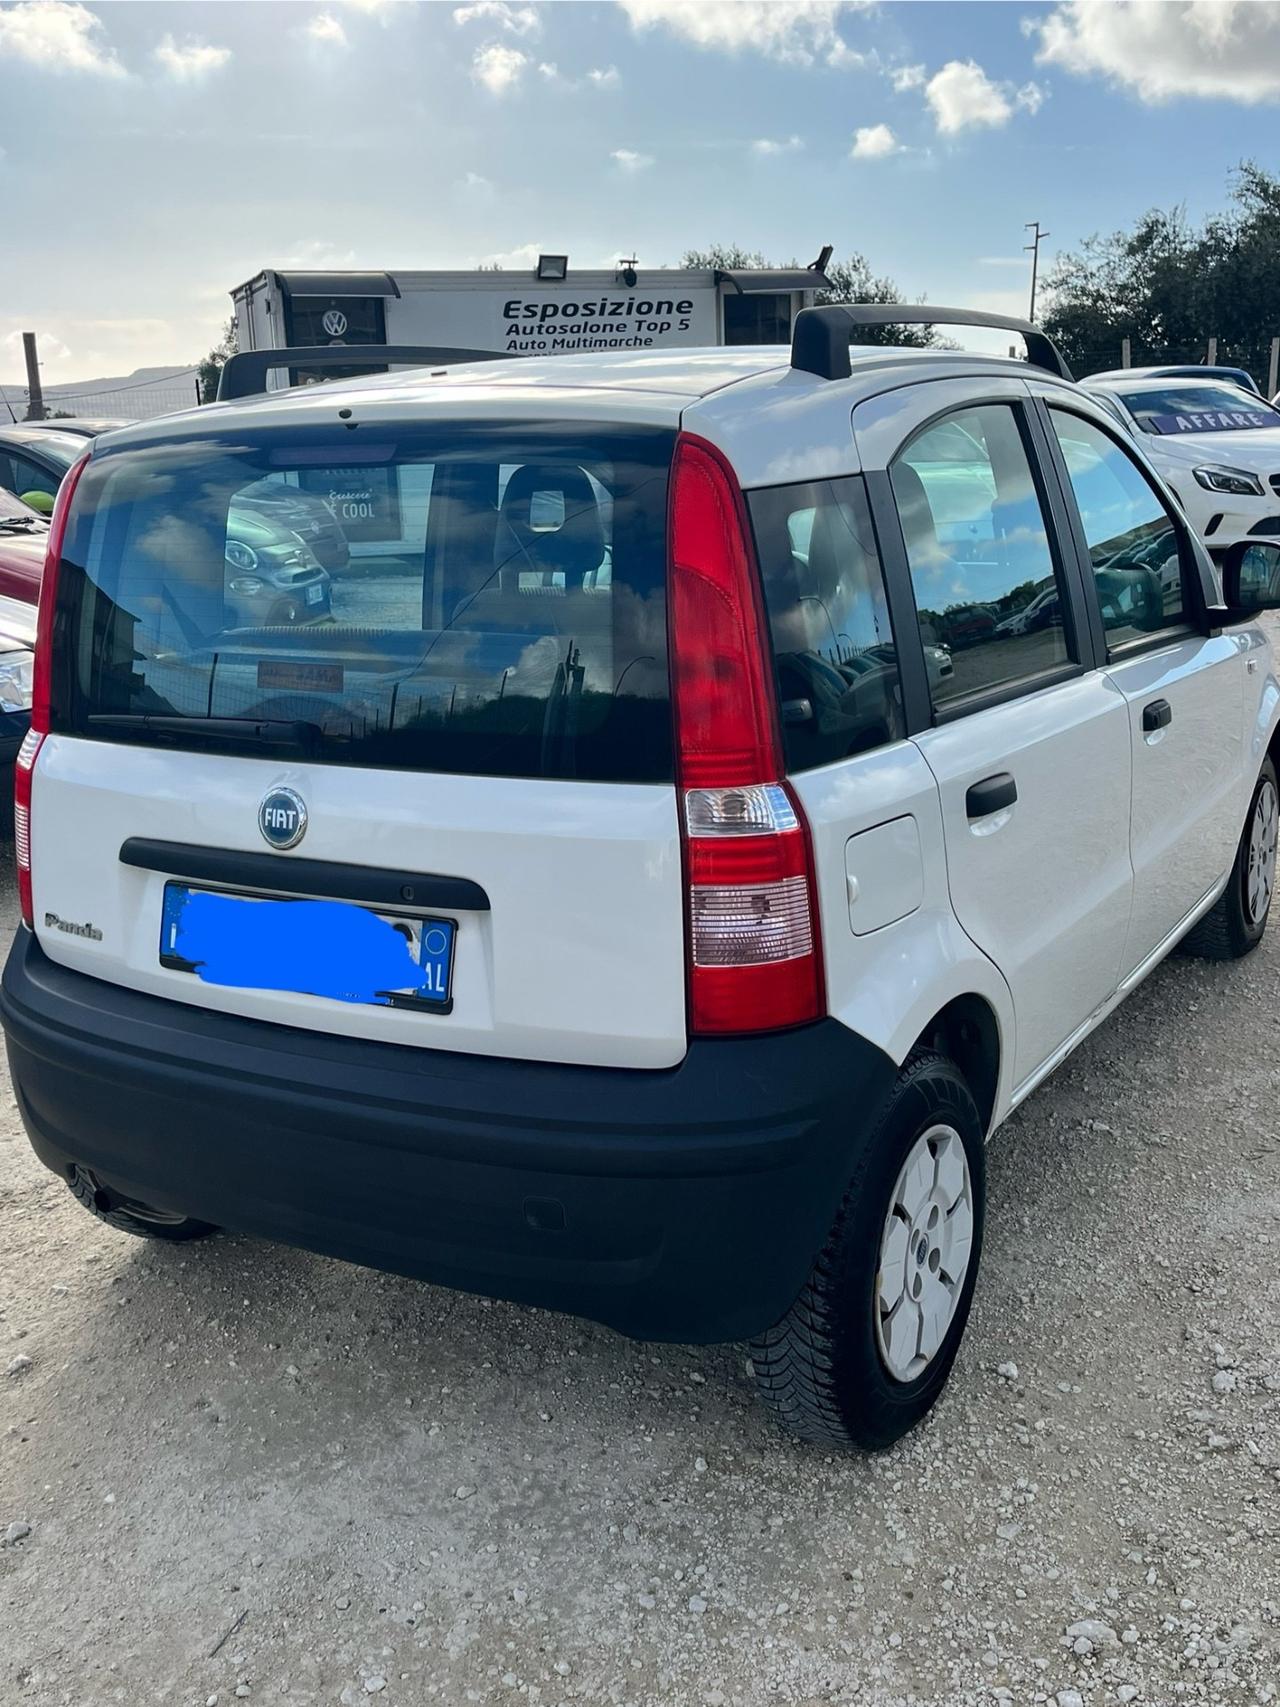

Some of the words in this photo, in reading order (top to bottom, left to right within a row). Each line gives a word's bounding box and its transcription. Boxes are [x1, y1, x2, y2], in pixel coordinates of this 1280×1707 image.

[503, 297, 694, 322] Esposizione
[505, 321, 627, 336] Autosalone
[634, 319, 671, 334] Top
[678, 318, 690, 331] 5
[506, 339, 547, 351] Auto
[551, 335, 653, 349] Multimarche
[1175, 413, 1263, 431] AFFARE
[342, 503, 375, 519] COOL
[265, 808, 297, 829] FIAT
[45, 912, 103, 941] Panda
